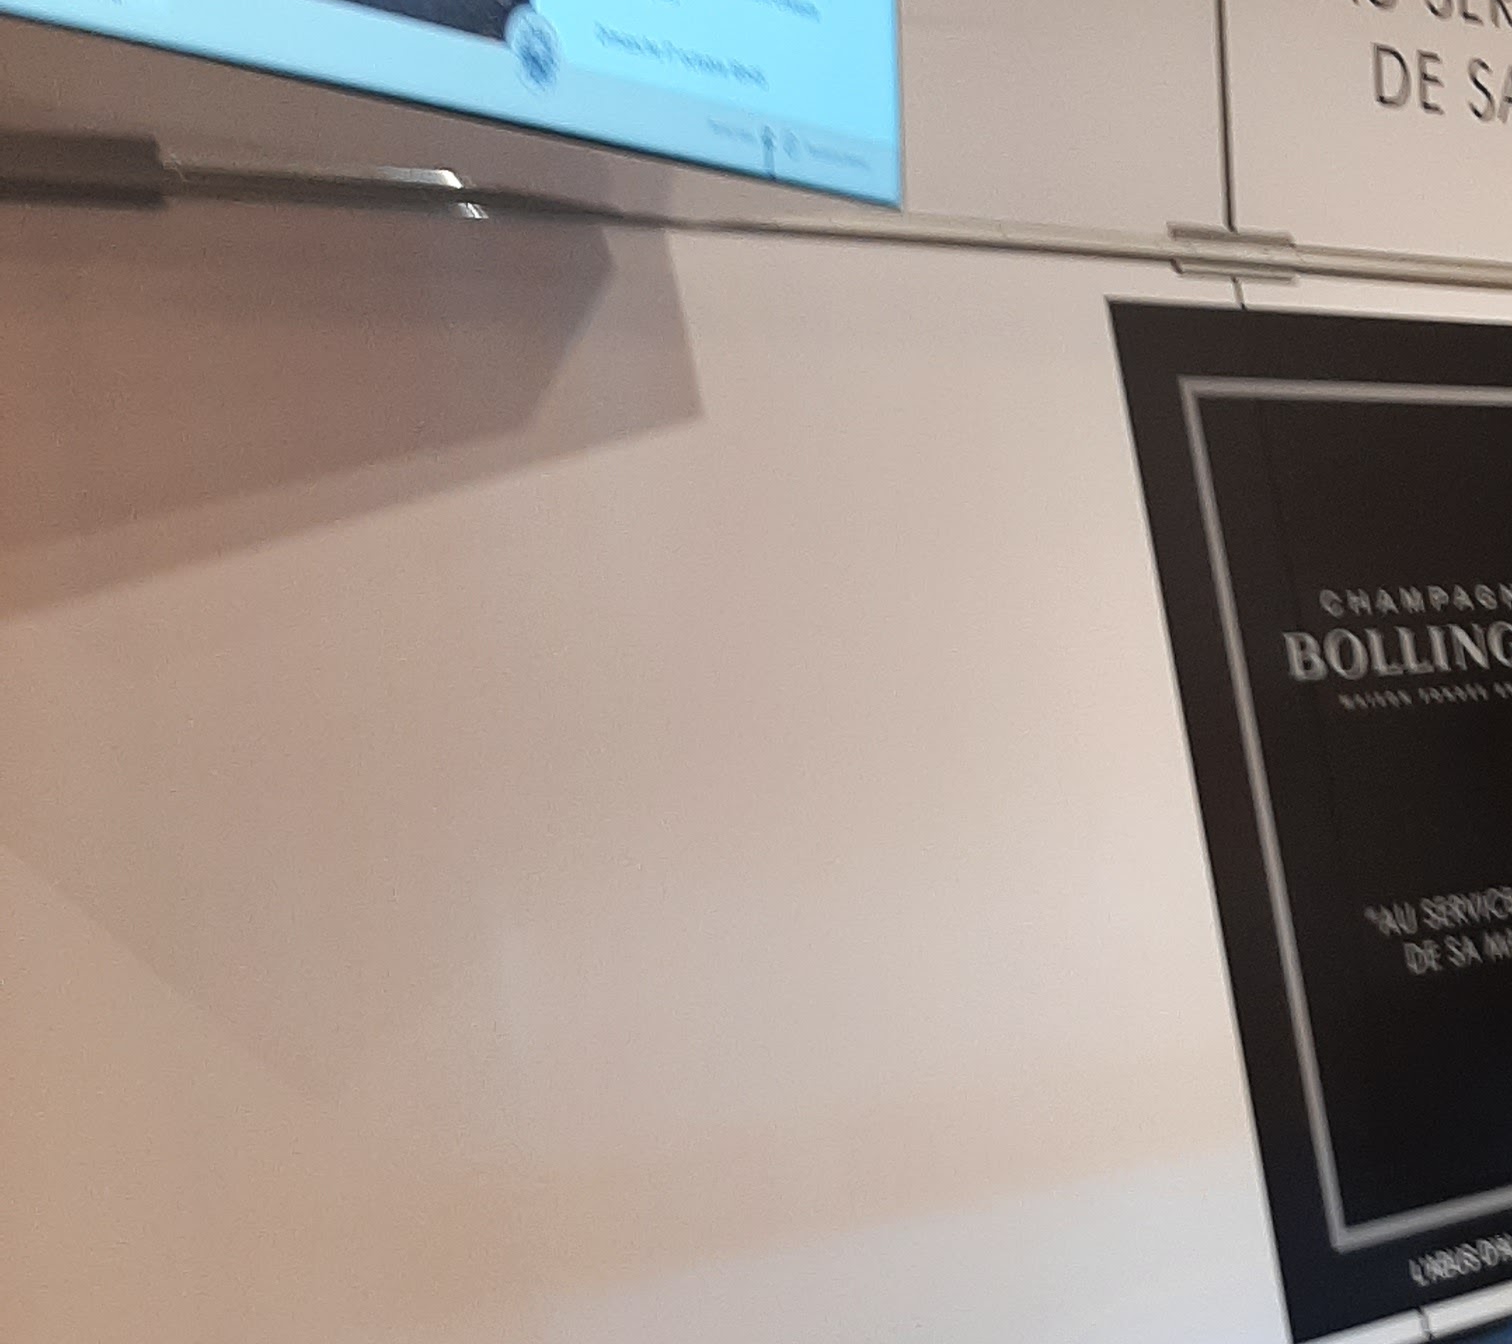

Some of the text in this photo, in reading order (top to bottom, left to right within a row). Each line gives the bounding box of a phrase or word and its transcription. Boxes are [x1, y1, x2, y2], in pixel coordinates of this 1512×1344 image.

[1372, 41, 1445, 116] DE
[1404, 939, 1443, 976] DE
[1445, 934, 1484, 968] SA
